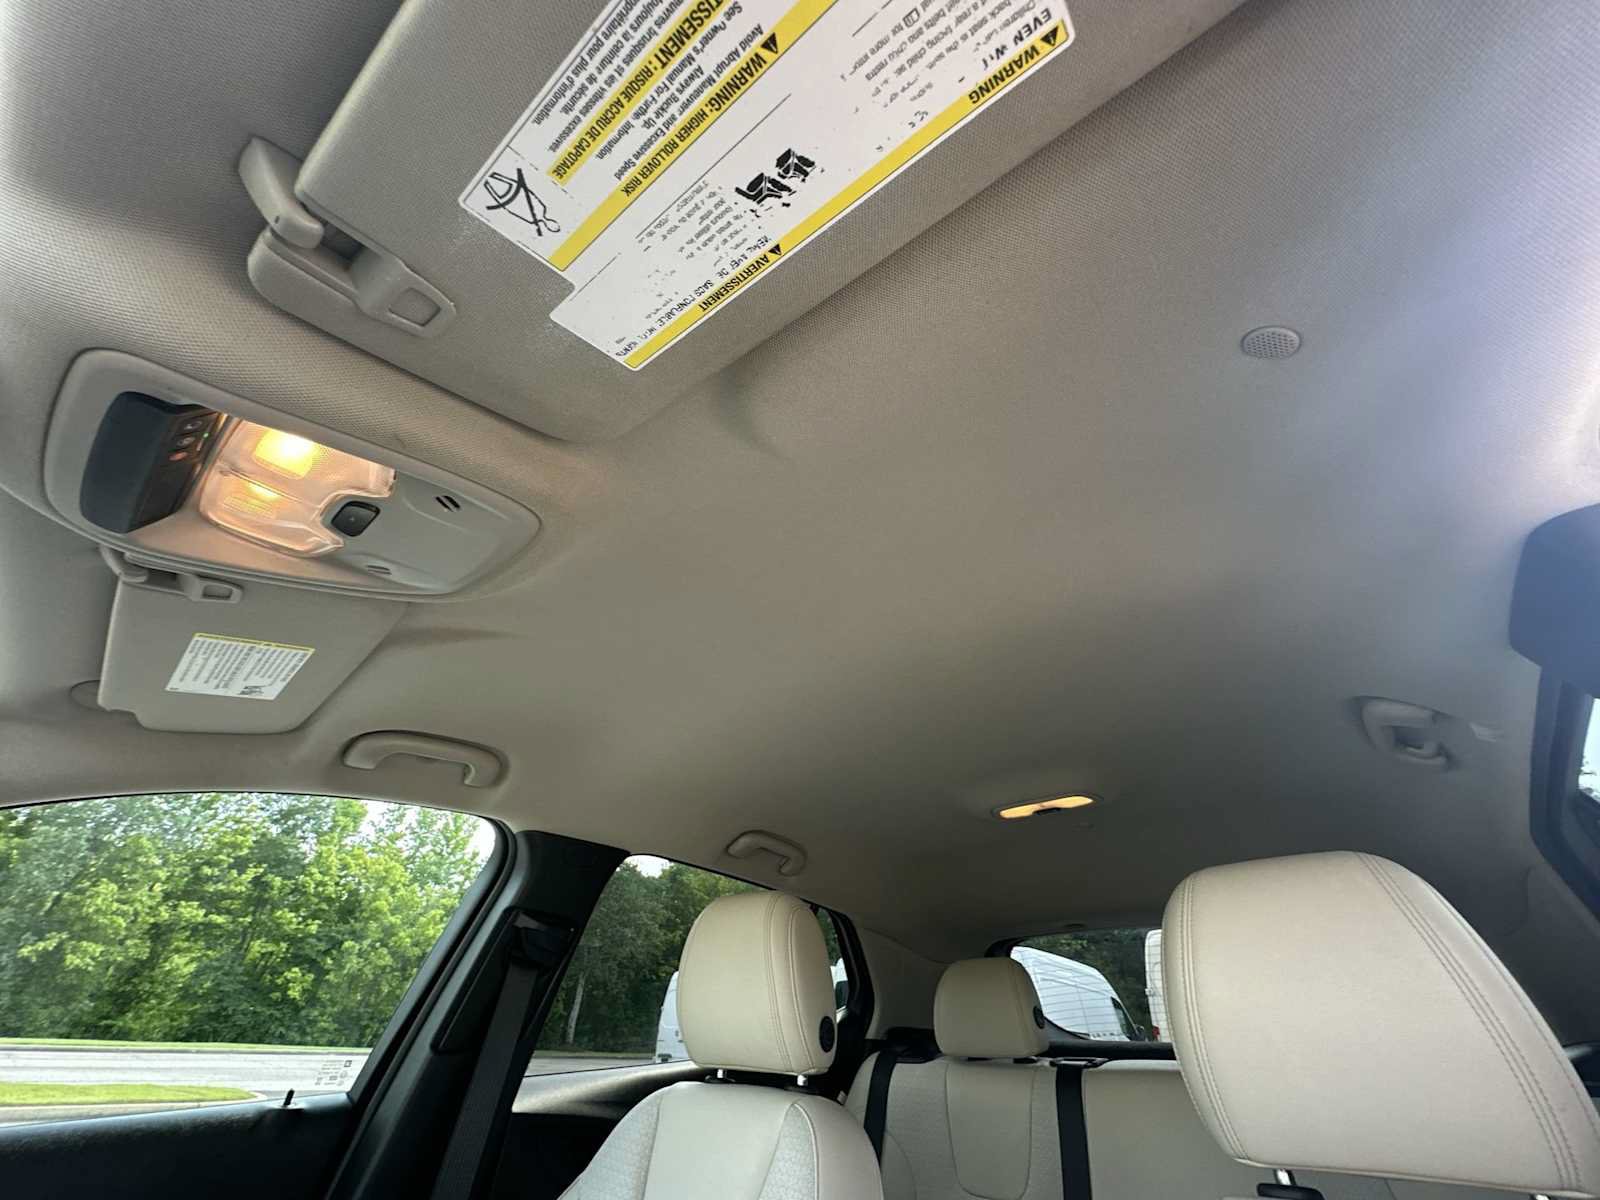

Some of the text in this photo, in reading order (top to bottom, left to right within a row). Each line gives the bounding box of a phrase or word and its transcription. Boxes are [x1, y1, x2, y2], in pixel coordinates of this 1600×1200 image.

[721, 1, 744, 21] See
[619, 29, 633, 42] la
[736, 22, 764, 52] Avoid
[1012, 7, 1052, 46] EVEN
[584, 35, 606, 61] pour
[593, 38, 626, 76] ceinture
[617, 25, 659, 67] brusques
[710, 46, 740, 76] Abrupt
[570, 55, 589, 78] plus
[583, 71, 597, 86] de
[663, 52, 695, 86] Manual
[673, 63, 706, 94] Always
[966, 43, 1040, 104] WARNING
[617, 64, 654, 103] RISQUE
[652, 81, 671, 98] For
[577, 85, 608, 118] vitesses
[593, 96, 625, 131] ACCRU
[582, 124, 601, 143] DE
[619, 51, 771, 197] WARNING: HIGHER ROLLOVER RISK
[638, 115, 658, 130] Up.
[661, 112, 679, 131] and
[550, 136, 593, 180] CAPOTAGE
[631, 126, 667, 161] Excessive
[612, 156, 637, 181] Speed
[692, 278, 715, 297] SACS
[696, 253, 770, 312] AVERTISSEMENT
